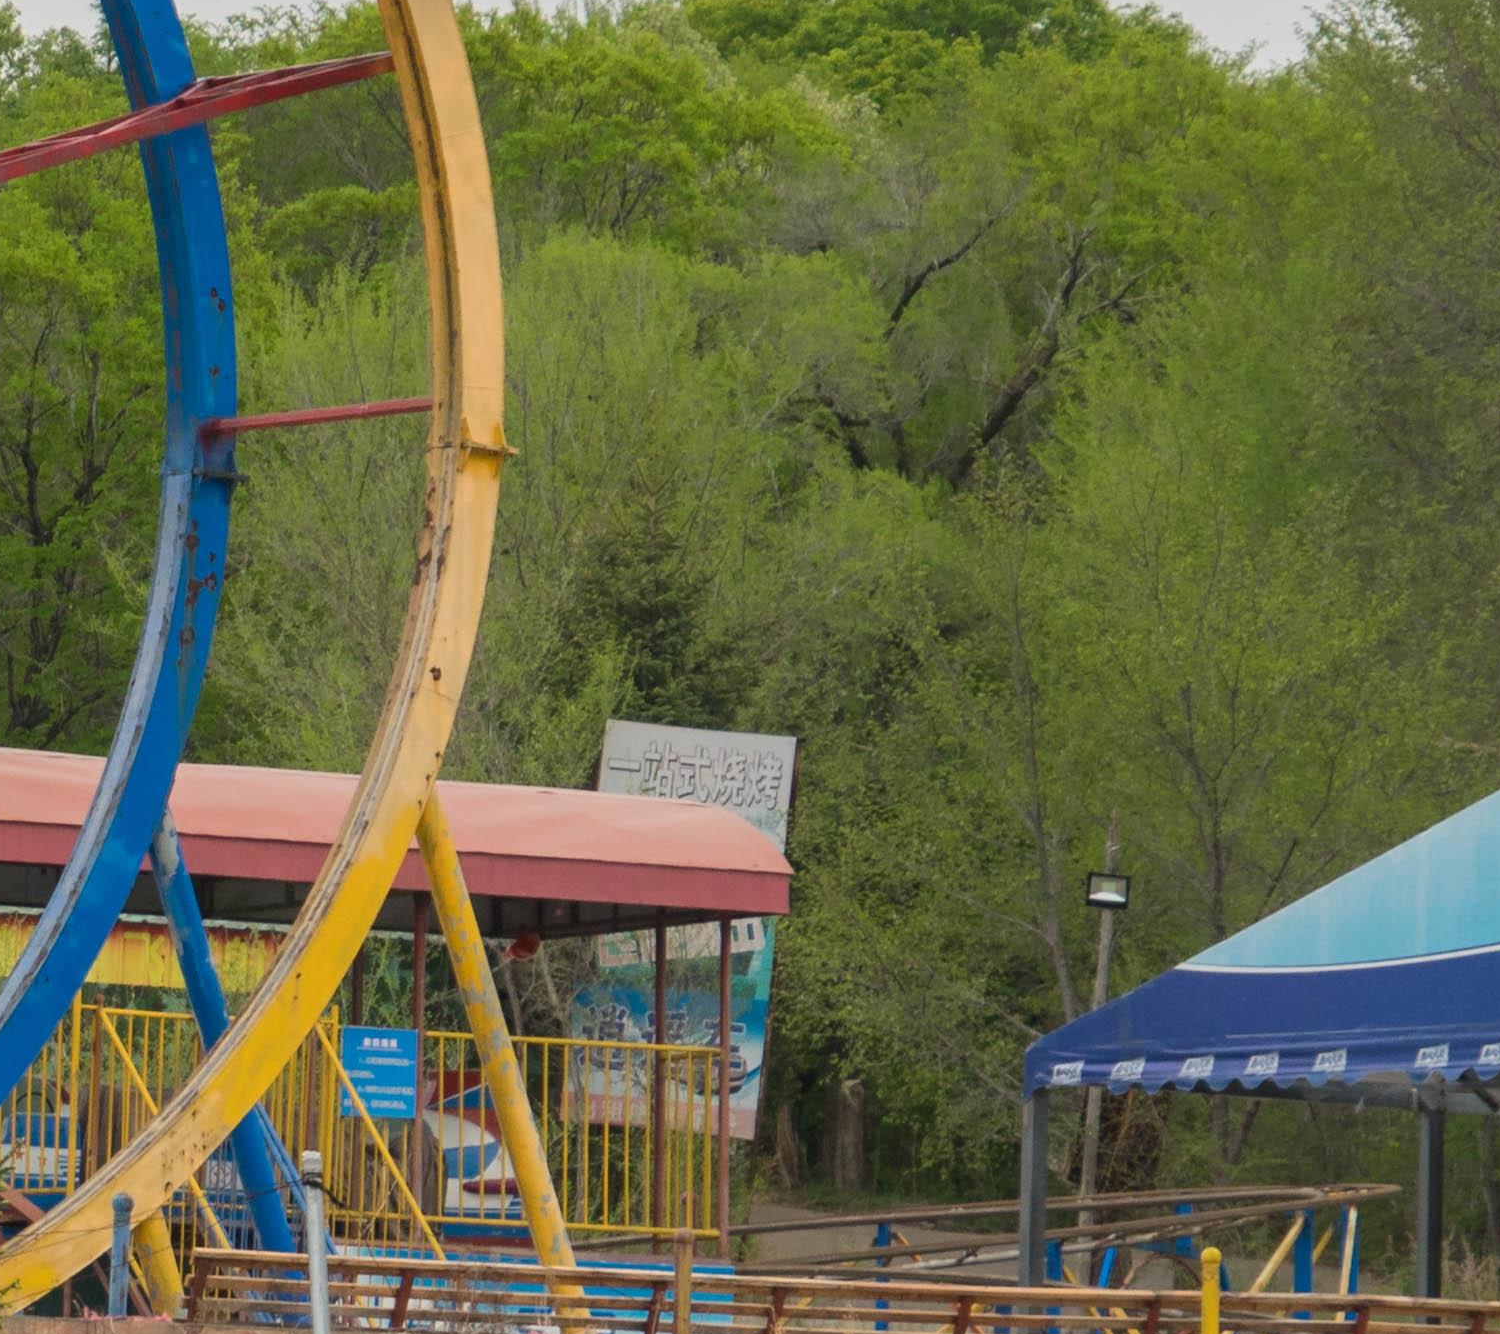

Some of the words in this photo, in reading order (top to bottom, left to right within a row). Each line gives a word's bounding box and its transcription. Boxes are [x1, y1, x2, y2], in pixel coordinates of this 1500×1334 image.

[607, 739, 785, 811] 一站式烧烤
